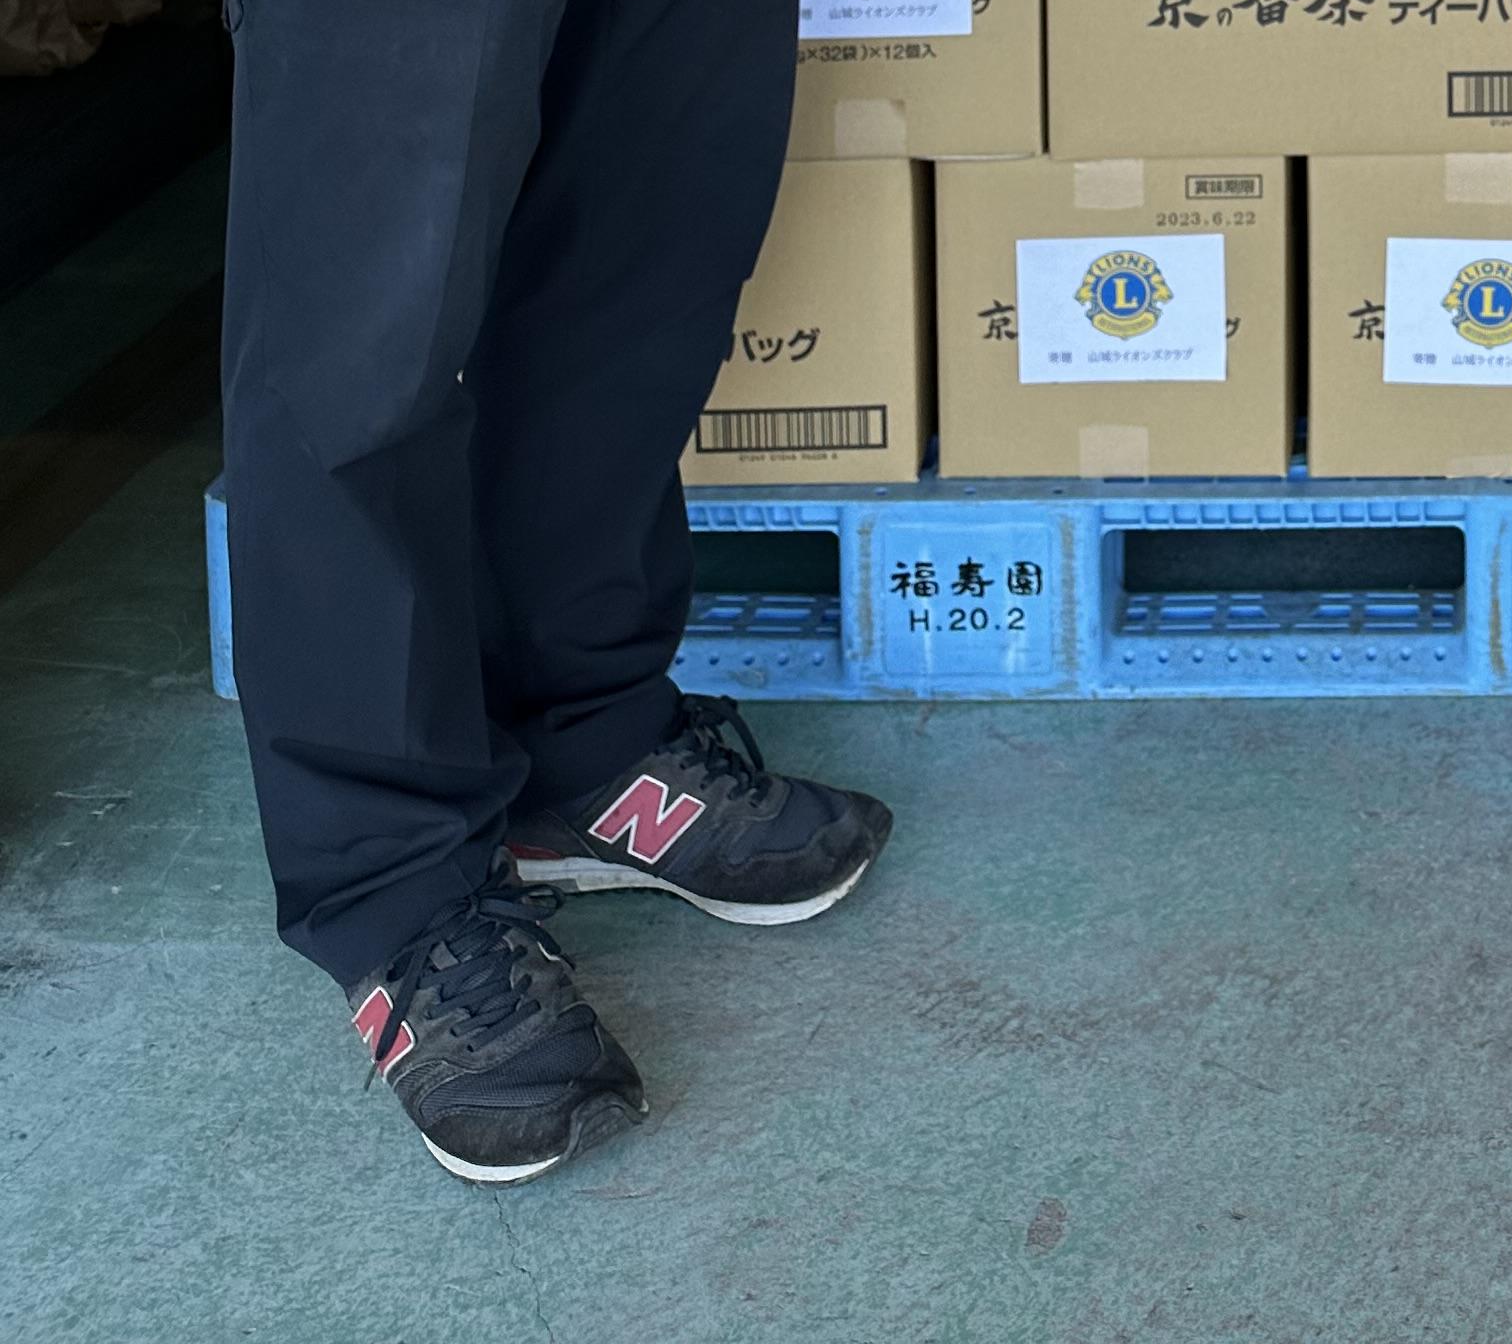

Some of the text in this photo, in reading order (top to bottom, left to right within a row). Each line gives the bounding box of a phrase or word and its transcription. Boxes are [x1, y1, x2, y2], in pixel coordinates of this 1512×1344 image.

[1155, 211, 1257, 227] 2023.6.22
[1113, 278, 1138, 309] L
[1480, 286, 1505, 318] L
[910, 608, 1026, 632] H.20.2
